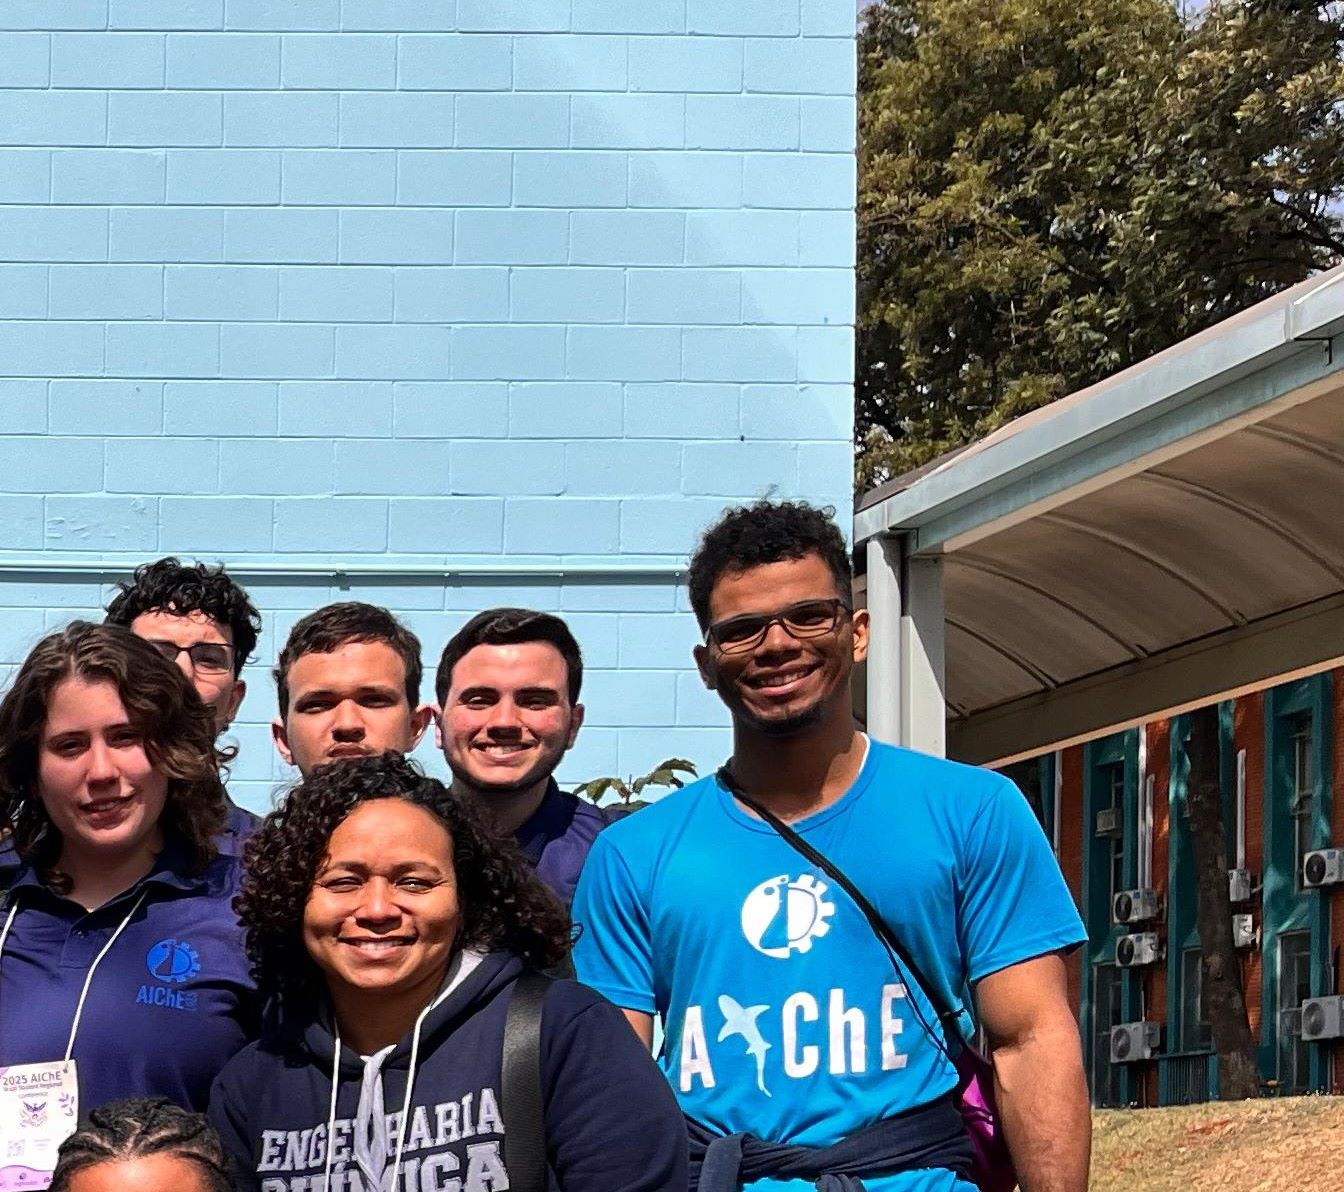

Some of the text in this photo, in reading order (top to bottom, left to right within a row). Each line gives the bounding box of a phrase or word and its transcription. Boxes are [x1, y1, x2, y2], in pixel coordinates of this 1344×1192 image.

[136, 985, 184, 1009] AIChE
[2, 1070, 62, 1086] 2025 AIChE
[257, 1087, 506, 1173] ENGEHARIA
